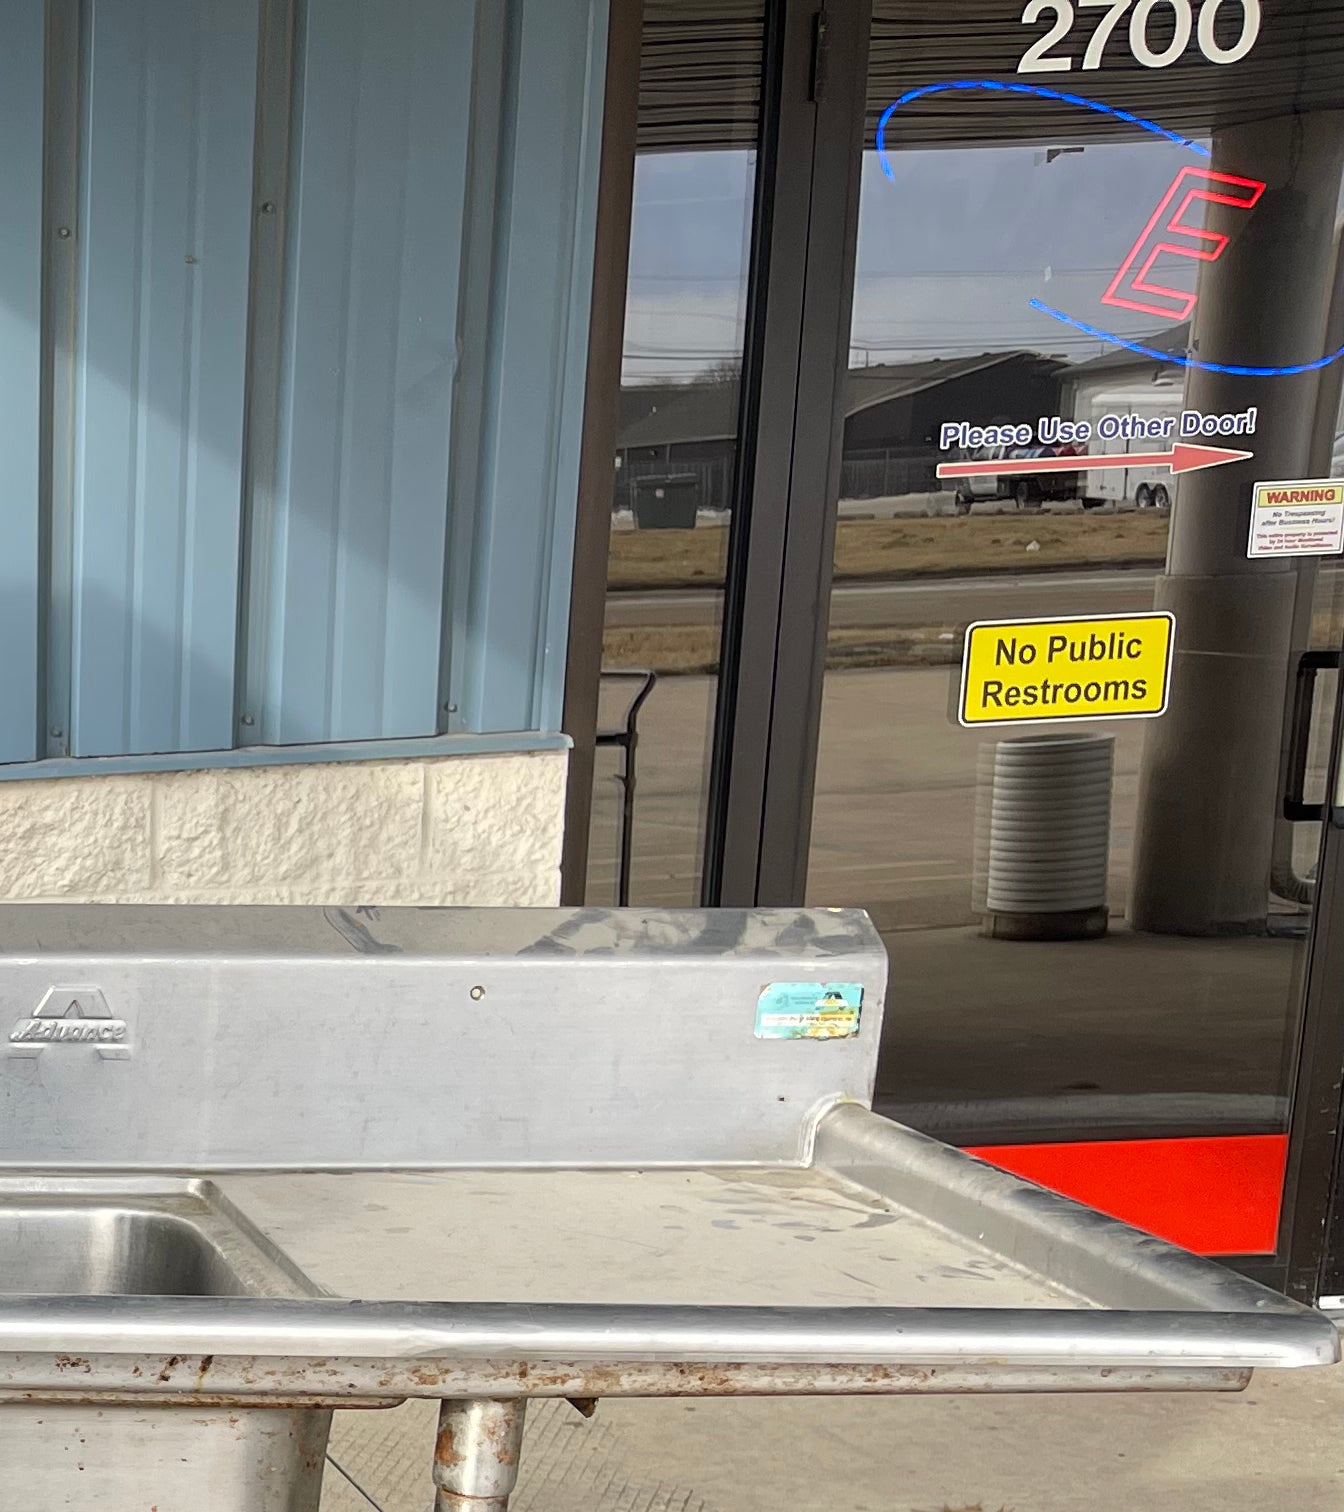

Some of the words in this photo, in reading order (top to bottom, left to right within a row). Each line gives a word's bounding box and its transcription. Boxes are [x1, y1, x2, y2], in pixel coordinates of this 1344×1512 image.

[1016, 0, 1261, 73] 2700
[940, 423, 1032, 449] Please
[1038, 417, 1090, 443] Use
[1097, 414, 1174, 439] Other
[1180, 408, 1257, 436] Door!
[1267, 489, 1335, 504] WARNING
[995, 638, 1037, 666] No
[1047, 632, 1143, 664] Public
[982, 678, 1148, 708] Restrooms
[8, 1020, 127, 1042] Advance
